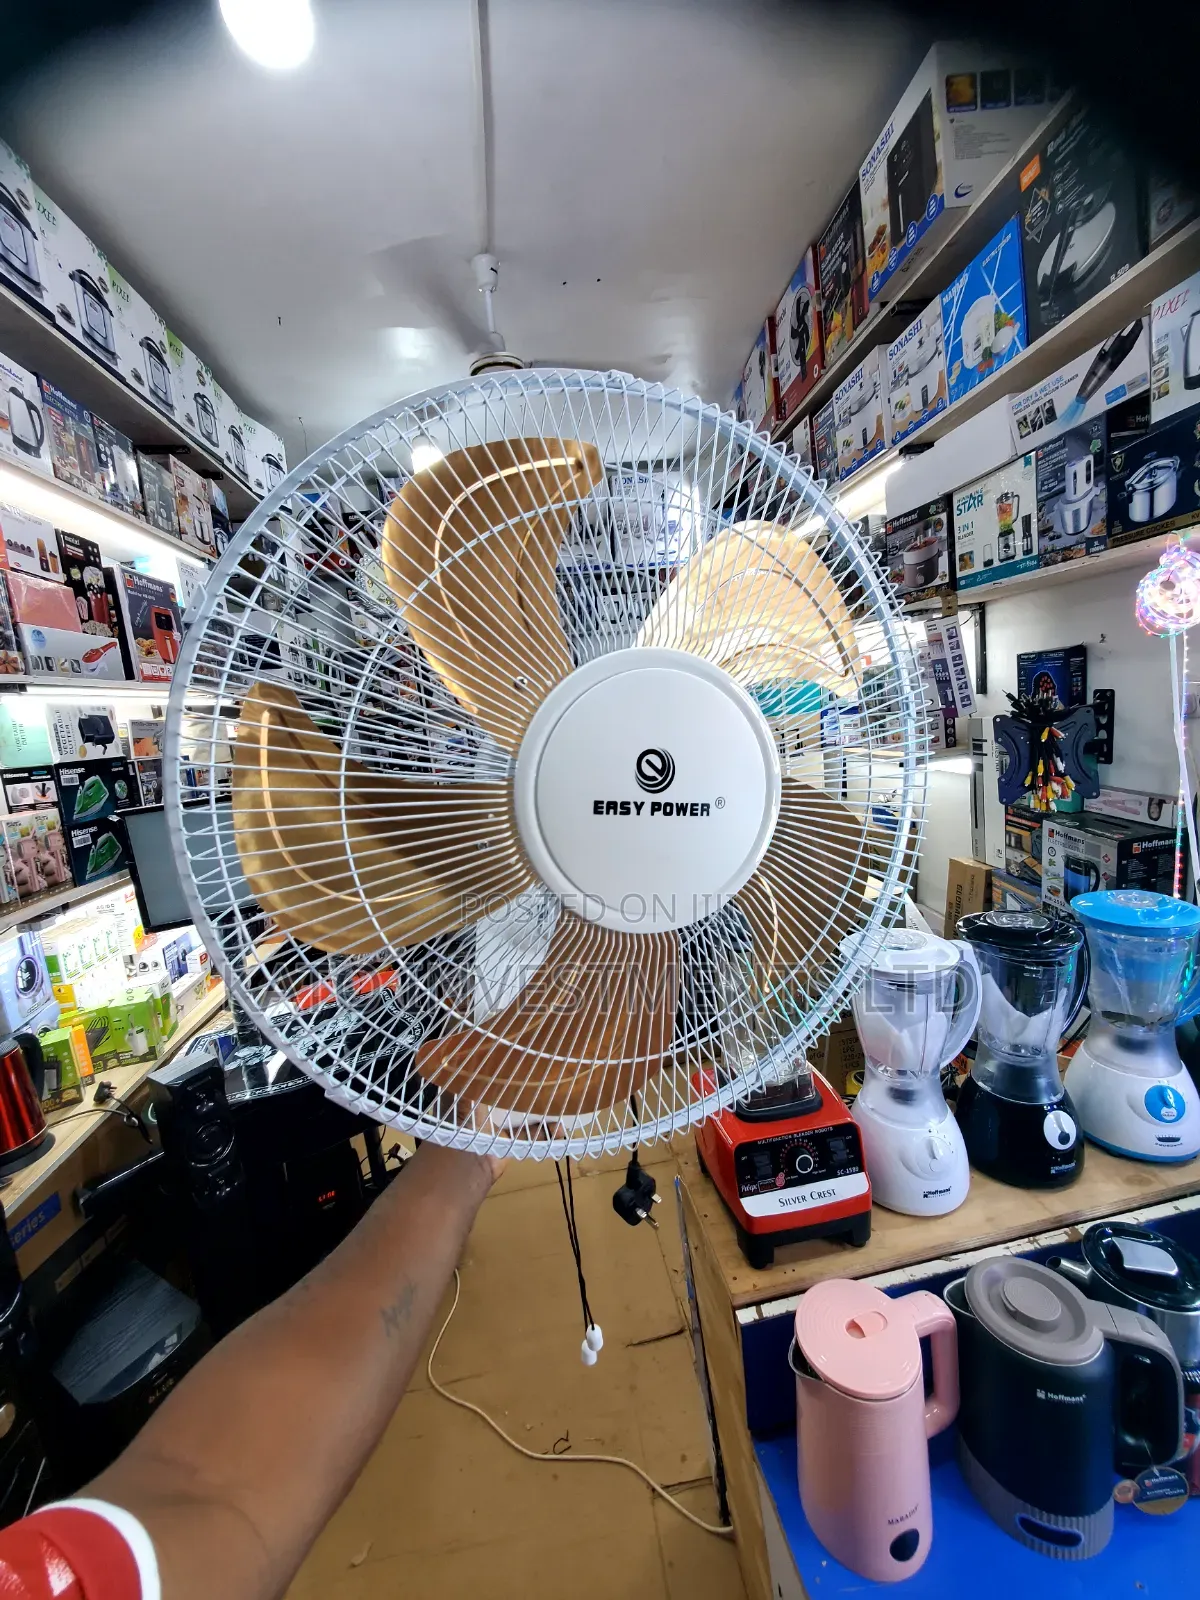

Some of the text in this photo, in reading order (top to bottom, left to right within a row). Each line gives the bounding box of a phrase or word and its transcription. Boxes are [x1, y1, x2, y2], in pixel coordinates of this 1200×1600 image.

[862, 121, 895, 181] SONASHI
[1153, 288, 1190, 321] PIXEL
[888, 318, 923, 361] SONASHI
[834, 367, 864, 405] SONASHI
[892, 511, 919, 528] Hoffmans
[133, 573, 164, 593] Hoffmans
[58, 766, 87, 776] Hisense
[592, 799, 711, 818] EASY POWER
[71, 825, 98, 838] Hisense
[1055, 830, 1085, 845] Hoffmans
[1142, 837, 1177, 849] Hoffmans
[1047, 1391, 1084, 1403] Hoffmans
